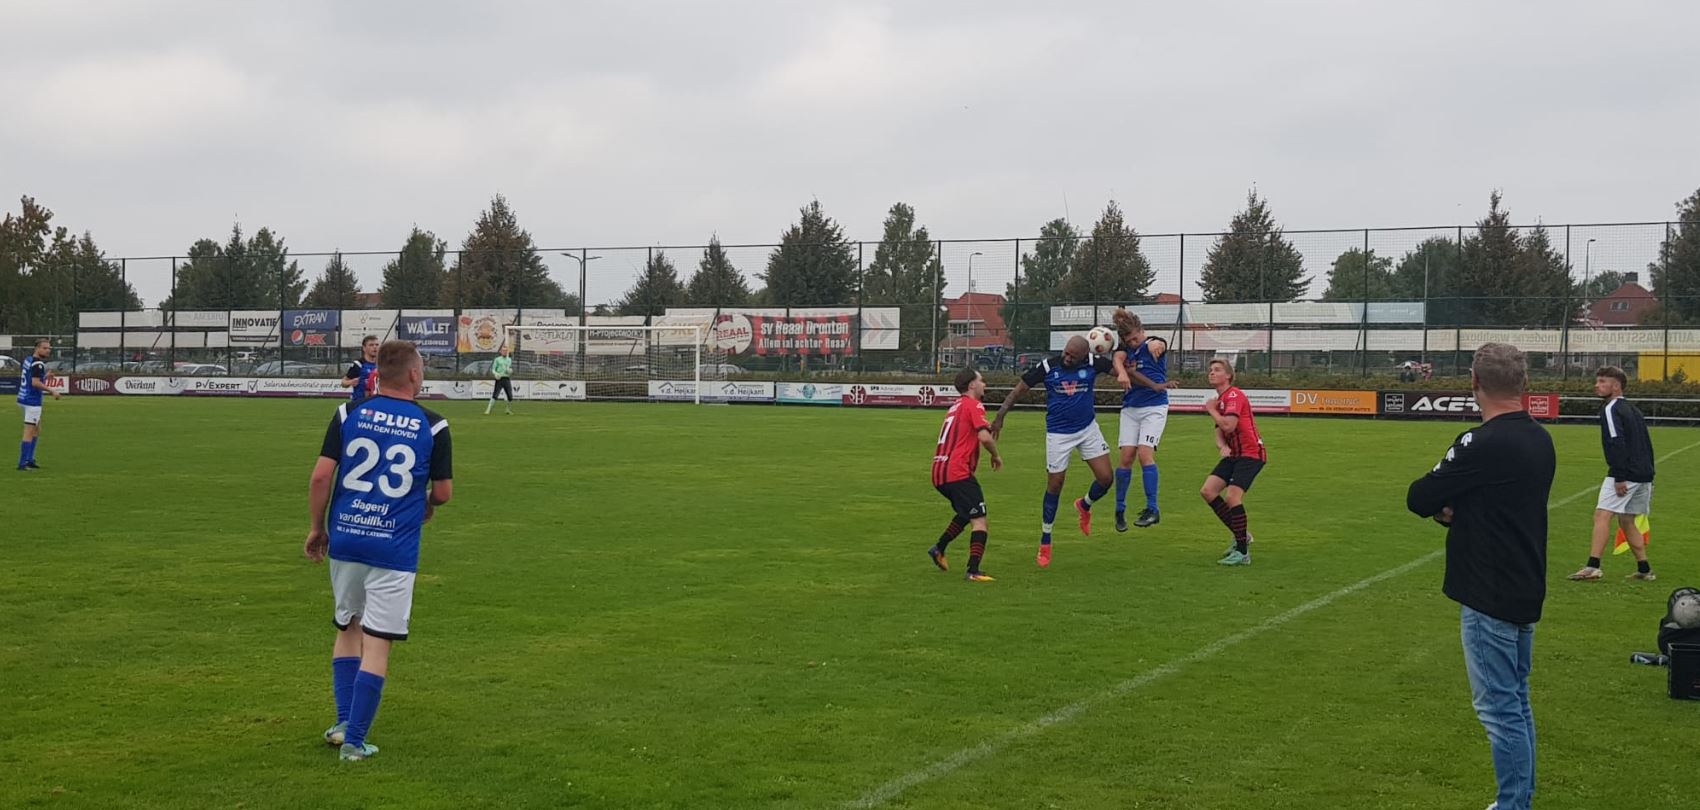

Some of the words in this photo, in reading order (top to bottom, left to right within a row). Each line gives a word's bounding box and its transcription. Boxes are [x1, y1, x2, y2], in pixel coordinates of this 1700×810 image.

[294, 311, 328, 327] EXTRAN
[407, 318, 450, 336] WALLET
[761, 322, 773, 335] sv
[775, 321, 804, 335] Reaal
[806, 320, 849, 335] Dronten
[794, 338, 824, 349] achter
[1295, 393, 1318, 405] DV
[373, 411, 421, 431] PLUS
[357, 421, 373, 431] VAN
[373, 425, 391, 434] DEN
[391, 427, 418, 440] HOVEN
[343, 437, 416, 498] 23
[351, 499, 390, 515] Slagerij
